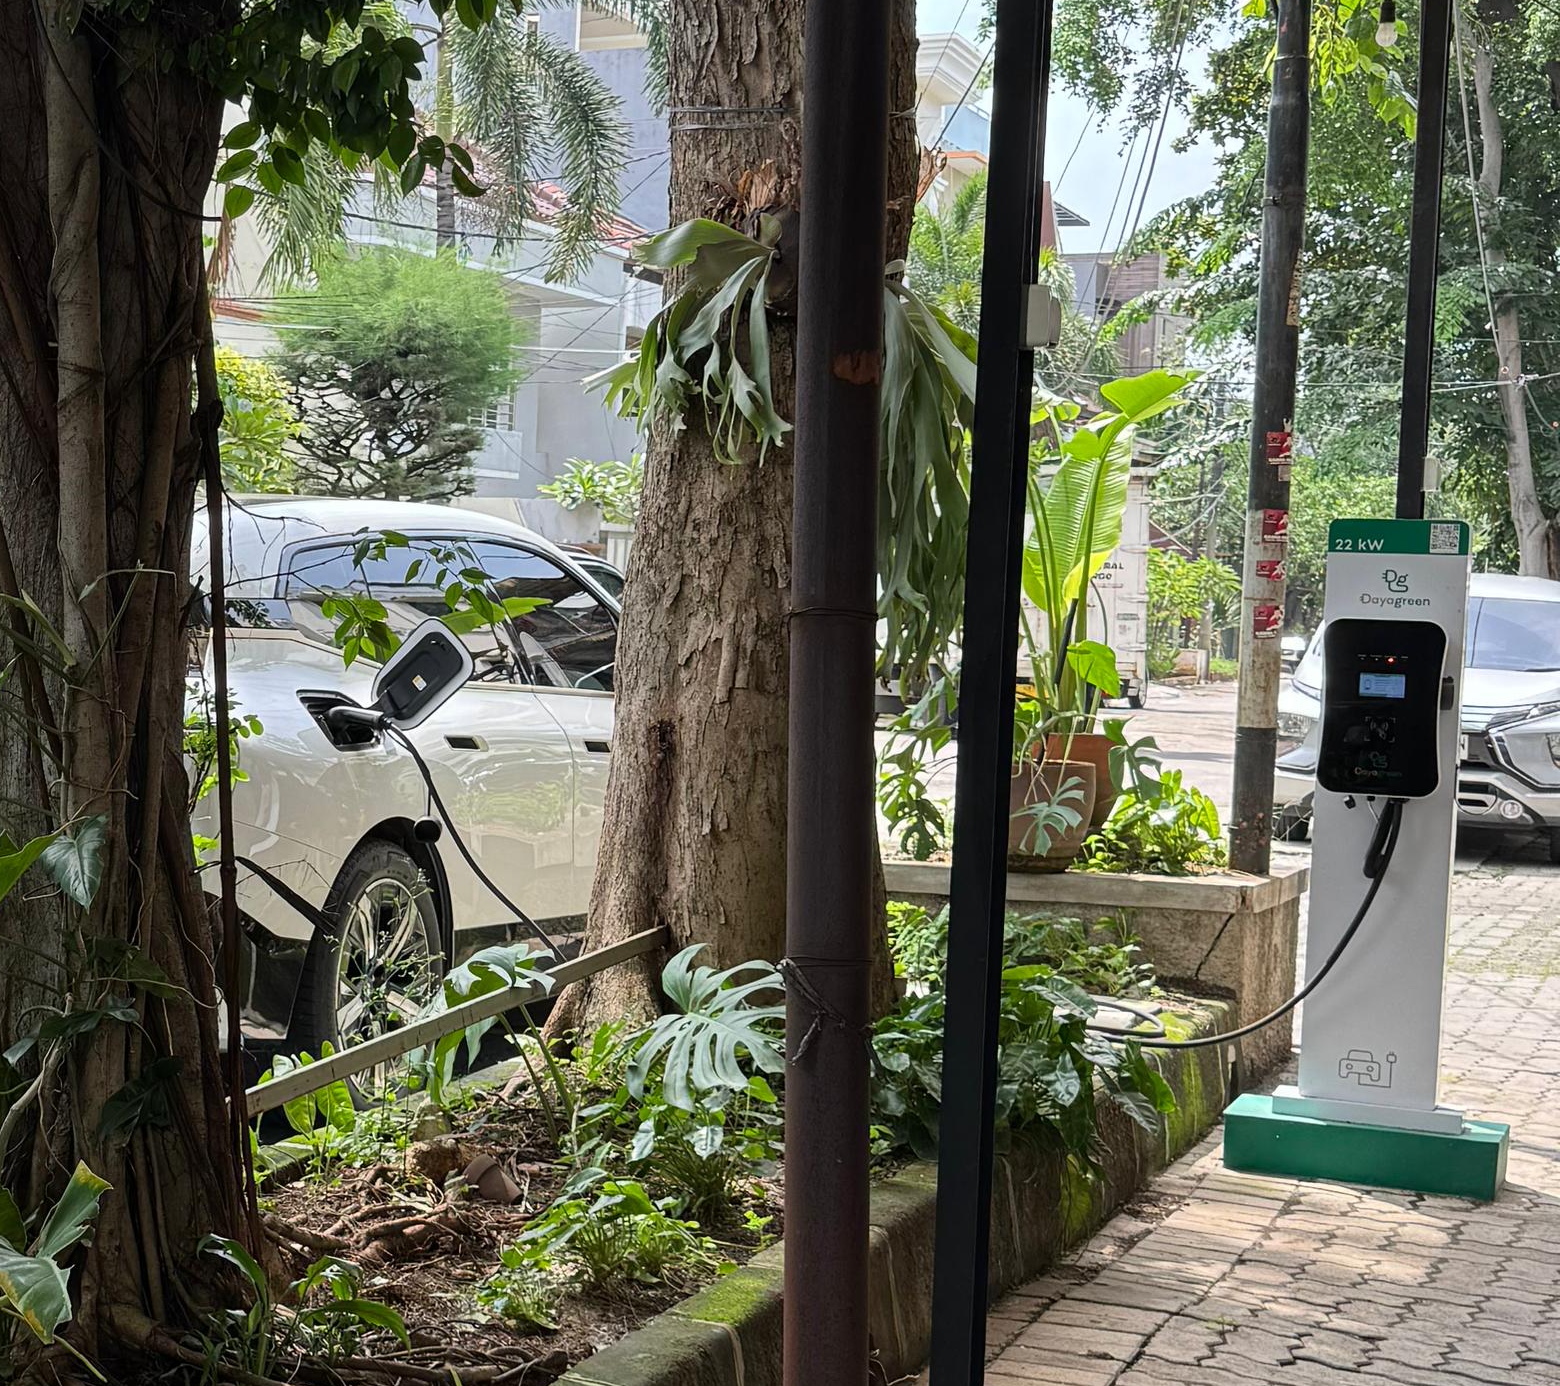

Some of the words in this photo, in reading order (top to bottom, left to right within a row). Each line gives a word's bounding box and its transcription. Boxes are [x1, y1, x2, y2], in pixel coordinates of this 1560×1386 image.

[1335, 538, 1353, 551] 22
[1358, 538, 1385, 551] kW
[1360, 593, 1430, 609] Dayagreen
